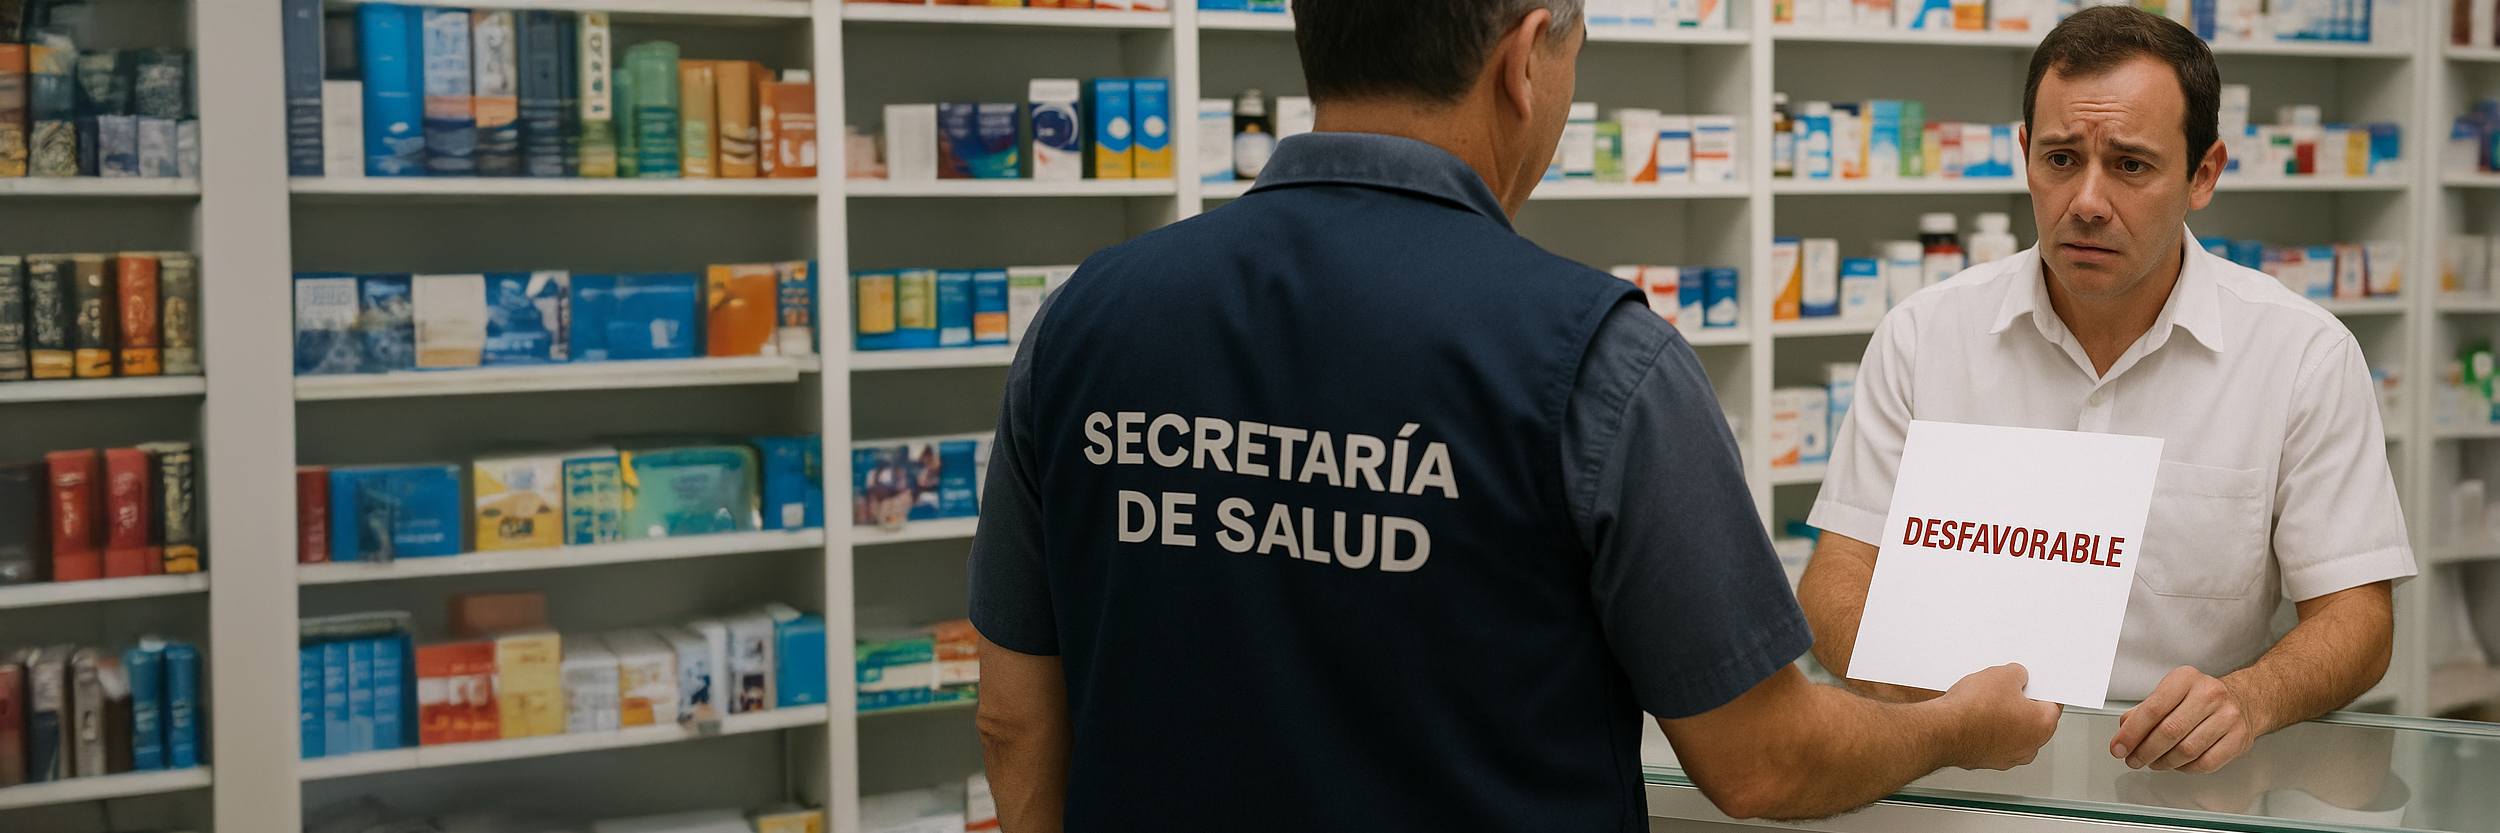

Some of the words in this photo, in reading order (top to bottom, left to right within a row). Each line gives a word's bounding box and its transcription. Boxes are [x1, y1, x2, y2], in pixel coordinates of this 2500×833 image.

[1083, 411, 1460, 499] SECRETARÍA
[1118, 490, 1197, 547] DE
[1215, 497, 1431, 572] SALUD
[1902, 516, 2126, 568] DESFAVORABLE
